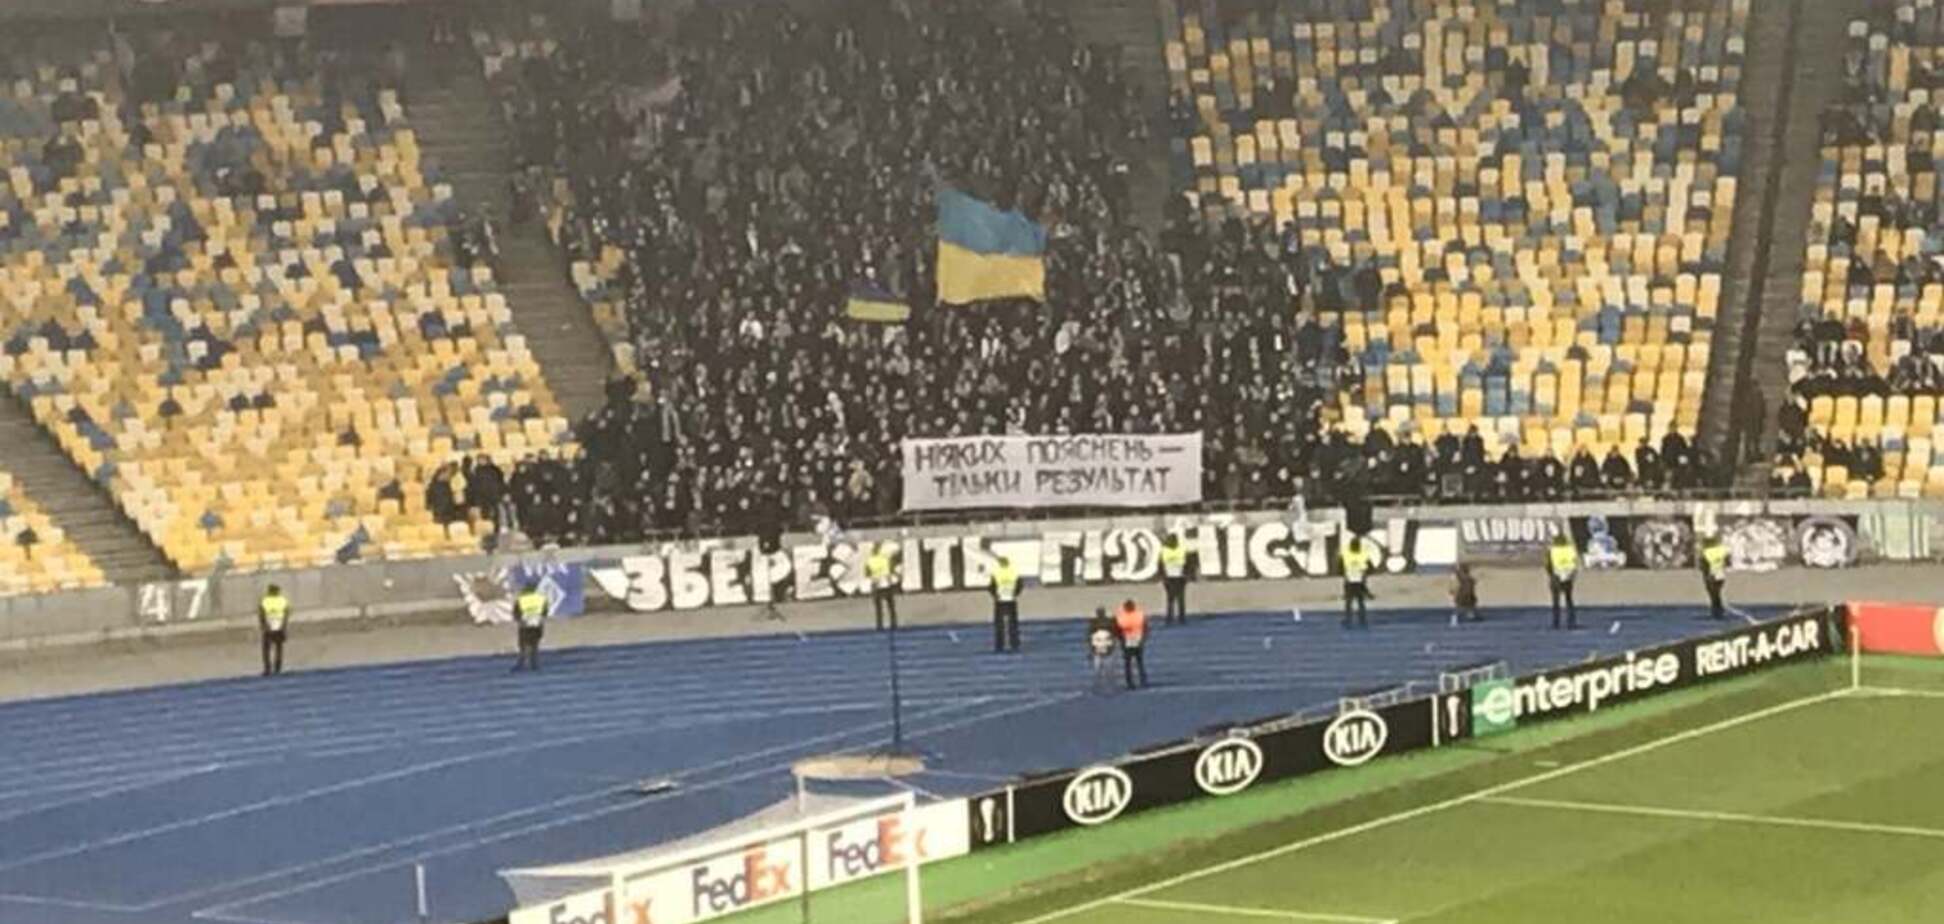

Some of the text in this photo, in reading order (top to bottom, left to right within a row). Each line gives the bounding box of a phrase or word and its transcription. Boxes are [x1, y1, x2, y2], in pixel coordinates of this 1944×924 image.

[1035, 466, 1171, 494] РЕЗУЛЬТАТ
[139, 579, 209, 622] 47
[1477, 620, 1821, 722] enterprise RENT-A-CAR
[1333, 718, 1376, 758] KIA
[1206, 745, 1252, 786] KIA
[1075, 776, 1121, 816] KIA
[692, 847, 791, 916] FedEx
